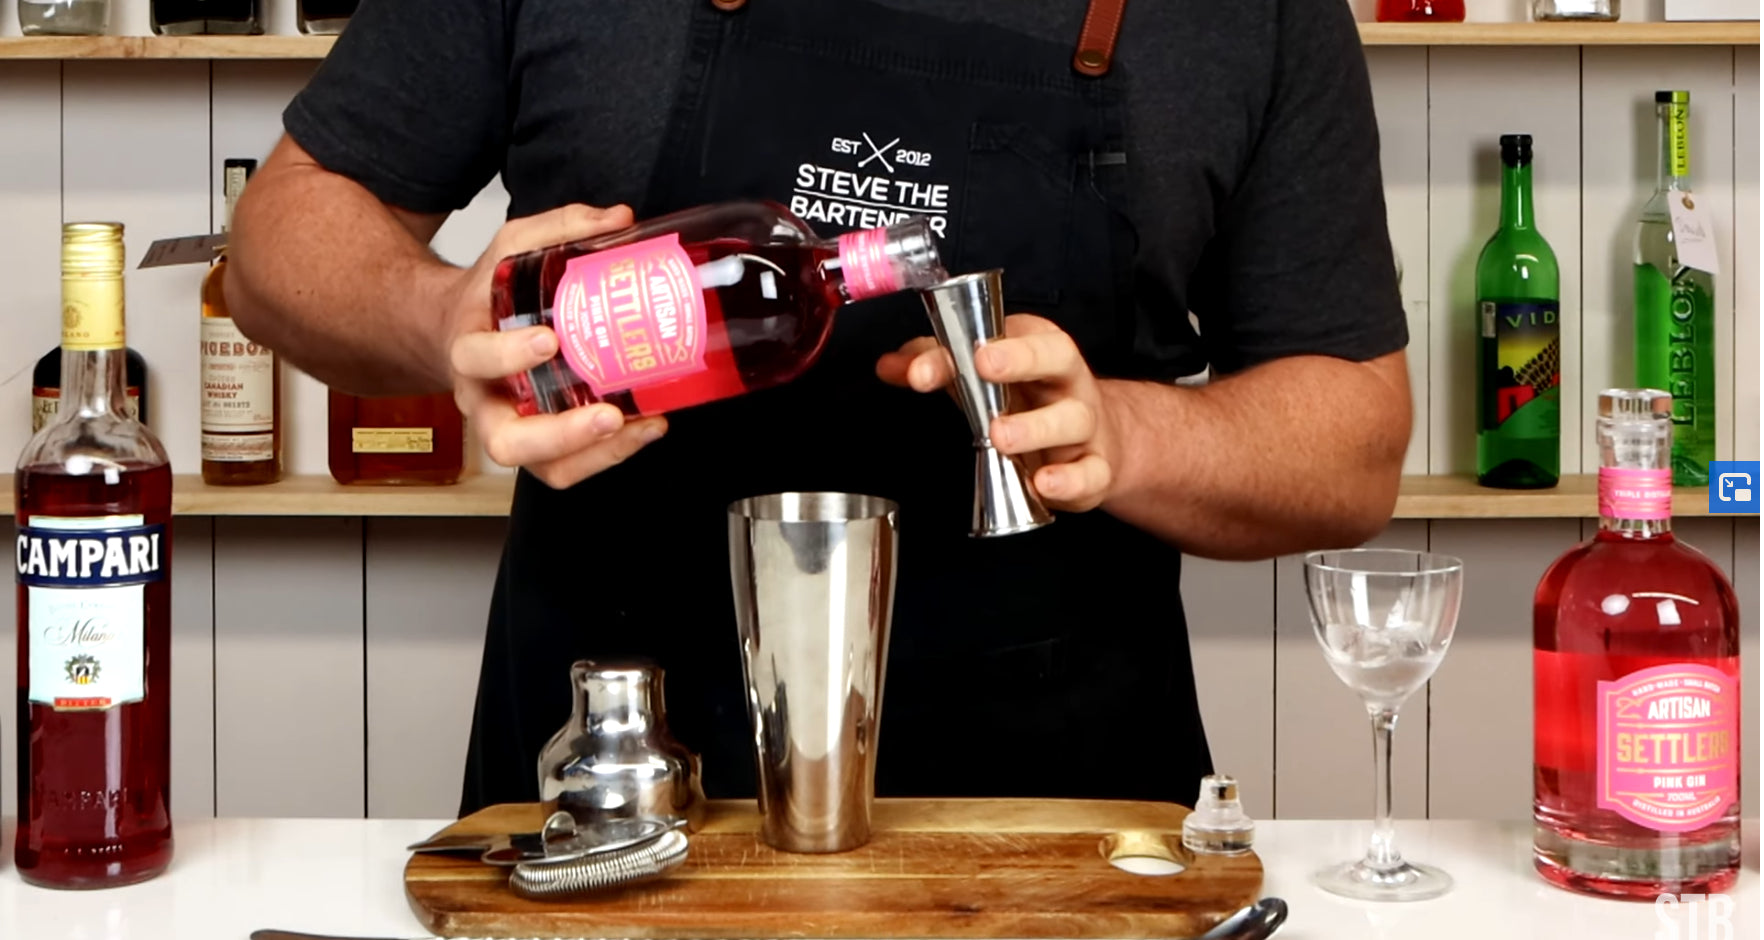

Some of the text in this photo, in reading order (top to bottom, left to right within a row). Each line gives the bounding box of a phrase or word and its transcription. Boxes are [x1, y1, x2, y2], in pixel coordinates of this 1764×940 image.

[831, 137, 932, 167] EST 2012
[1676, 109, 1686, 169] LEBLON
[796, 163, 950, 208] STEVE THE
[790, 195, 947, 238] BARTENR
[589, 295, 610, 348] PINK GIN
[609, 258, 657, 372] SETTLERS
[650, 276, 677, 339] ARTISAN
[204, 382, 244, 391] CANADIAN
[207, 391, 238, 399] WHISKY
[17, 533, 160, 578] CAMPARI
[1632, 679, 1679, 697] HAND-MADE
[1647, 696, 1711, 720] ARTISAN
[1616, 730, 1729, 765] SETTLERS
[1653, 774, 1707, 789] PINK GIN
[1632, 795, 1721, 817] DISTILLED IN AUSTRALIA
